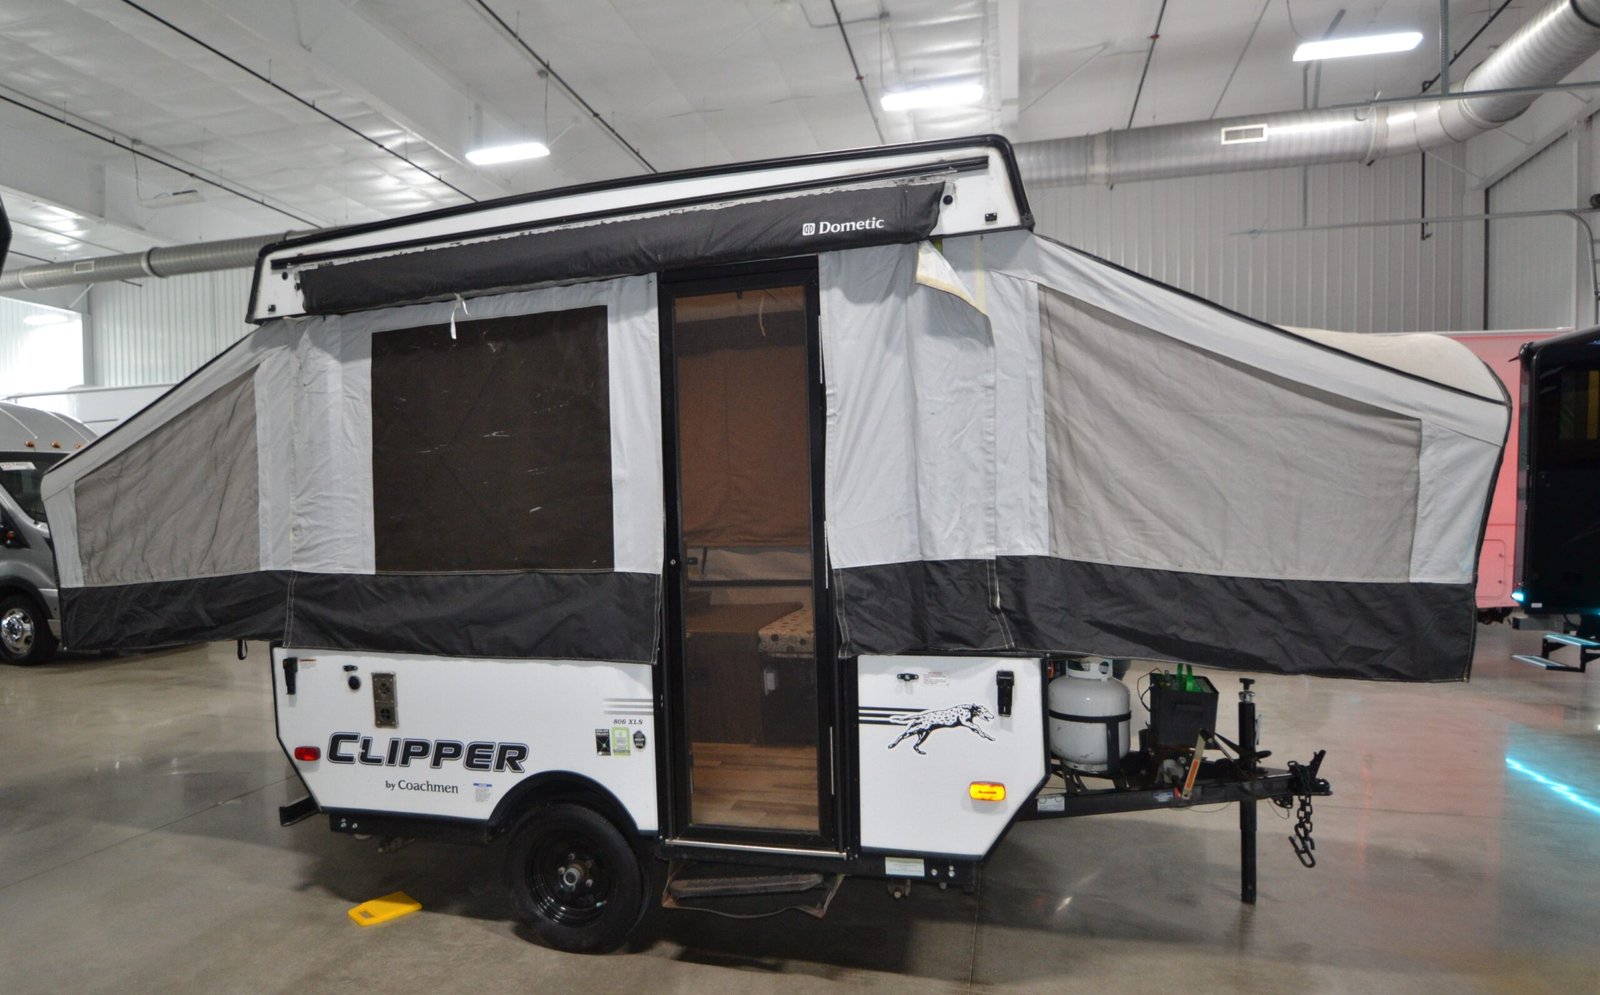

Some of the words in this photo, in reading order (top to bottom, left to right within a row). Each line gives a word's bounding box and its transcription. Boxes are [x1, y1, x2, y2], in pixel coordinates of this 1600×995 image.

[818, 217, 885, 235] Dometic
[327, 732, 529, 773] CLIPPER
[385, 780, 396, 791] by
[398, 780, 459, 794] Coachmen
